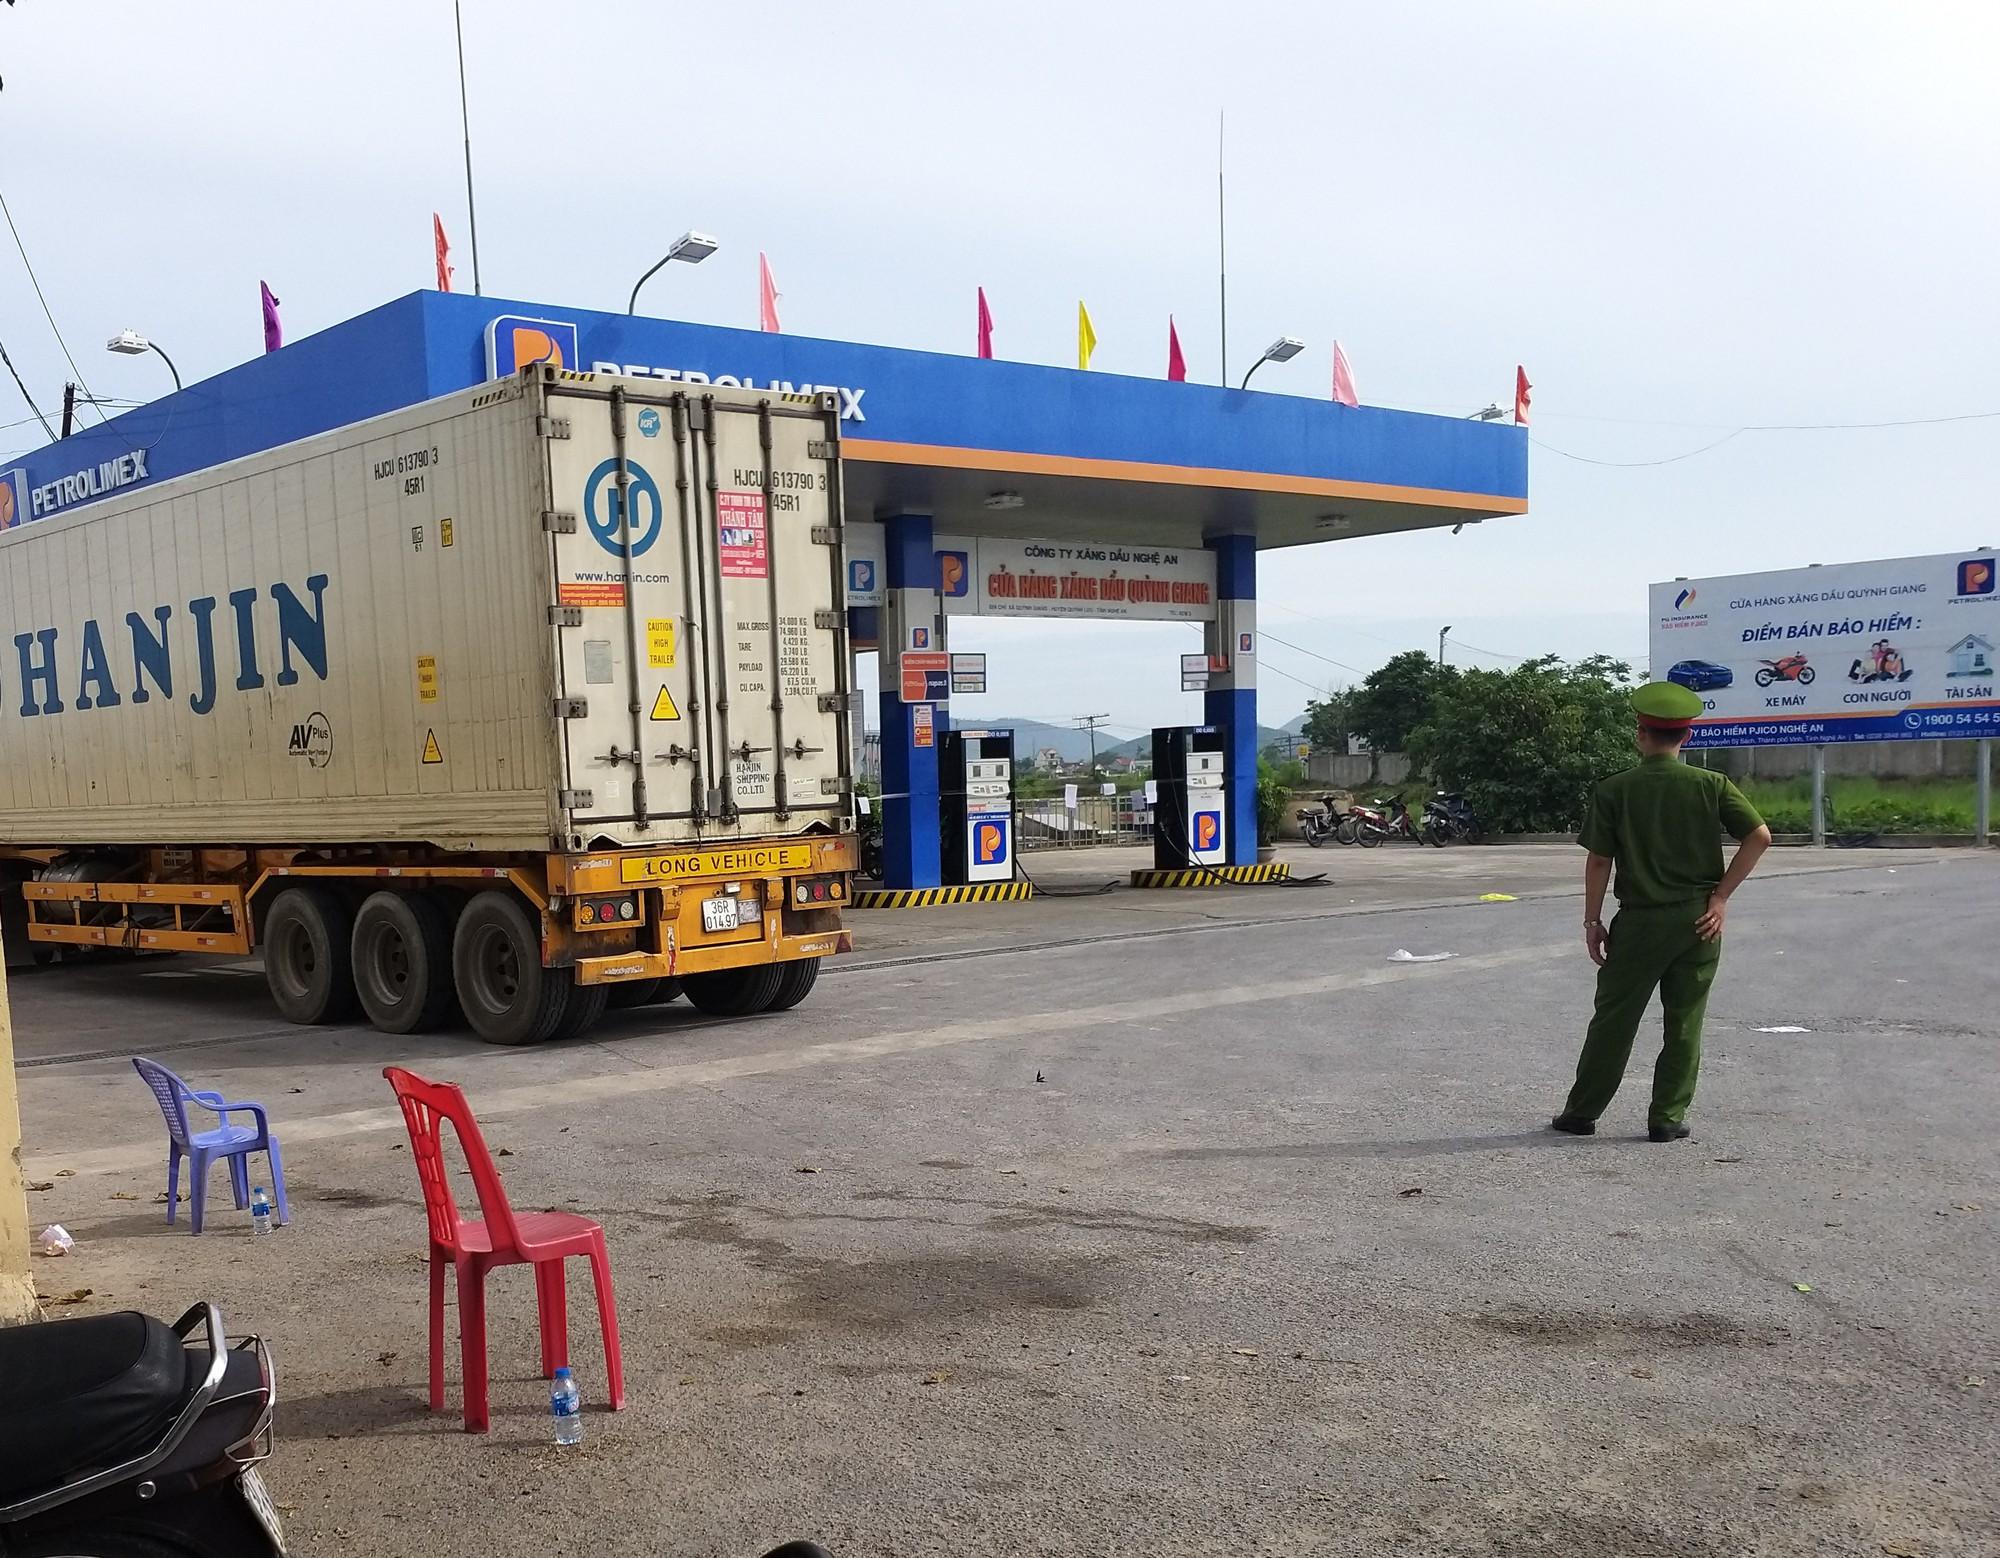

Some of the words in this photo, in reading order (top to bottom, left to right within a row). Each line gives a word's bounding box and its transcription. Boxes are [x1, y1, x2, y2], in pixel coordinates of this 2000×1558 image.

[374, 459, 395, 480] HJCU
[398, 450, 429, 473] 613790
[432, 447, 439, 465] 3
[31, 449, 149, 516] PETROLIMEX
[404, 475, 425, 496] 45R1
[734, 468, 762, 487] HJCU
[772, 471, 814, 491] 613790
[818, 473, 826, 490] 3
[773, 494, 801, 512] 45R1
[1024, 545, 1055, 559] CÔNG
[1059, 548, 1072, 559] TY
[1076, 548, 1106, 560] XĂNG
[1133, 551, 1161, 566] NGHỆ
[1163, 554, 1178, 565] AN
[575, 571, 670, 583] www.hanin.com
[988, 564, 1017, 597] CỬA
[1018, 568, 1057, 598] HÀNG
[1059, 571, 1098, 600] XĂNG
[1127, 574, 1170, 604] QUỲNH
[1171, 581, 1210, 605] GIANG
[1730, 598, 1752, 609] CỬA
[1754, 595, 1785, 607] HÀNG
[1788, 592, 1819, 604] XĂNG
[1847, 585, 1887, 599] QUỲNH
[1889, 583, 1927, 595] GIANG
[1948, 595, 2000, 604] PETROLIME
[1670, 614, 1708, 622] INSURANCE
[647, 622, 673, 632] CAUTION
[1742, 621, 1783, 642] ĐIỂM
[1786, 621, 1823, 639] BÁN
[1827, 617, 1864, 636] BẢO
[1868, 611, 1913, 633] HIỂM
[14, 573, 329, 717] HANJIN
[653, 639, 669, 648] HIGH
[738, 643, 752, 652] TARE
[649, 655, 675, 665] TRAILER
[738, 663, 763, 672] PAYLOAD
[1843, 692, 1868, 703] CON
[1870, 690, 1911, 702] NGƯỜI
[1945, 687, 1964, 699] TÀI
[1966, 686, 1992, 698] SẢN
[1765, 697, 1780, 707] XE
[1782, 694, 1807, 706] MÁY
[1925, 714, 1953, 725] 1900
[1956, 713, 1972, 724] 54
[1974, 712, 1990, 723] 54
[289, 724, 313, 750] AV
[312, 727, 329, 740] Plus
[1700, 726, 1721, 737] BẢO
[1723, 724, 1747, 736] HIỂM
[1749, 726, 1778, 735] PJICO
[1779, 724, 1808, 734] NGHỆ
[1809, 724, 1824, 733] AN
[736, 762, 761, 773] HANJIN
[736, 773, 770, 784] SHIPPING
[648, 857, 701, 875] LONG
[711, 850, 789, 865] VEHICLE
[712, 901, 729, 914] 36R
[706, 913, 737, 929] 014.97
